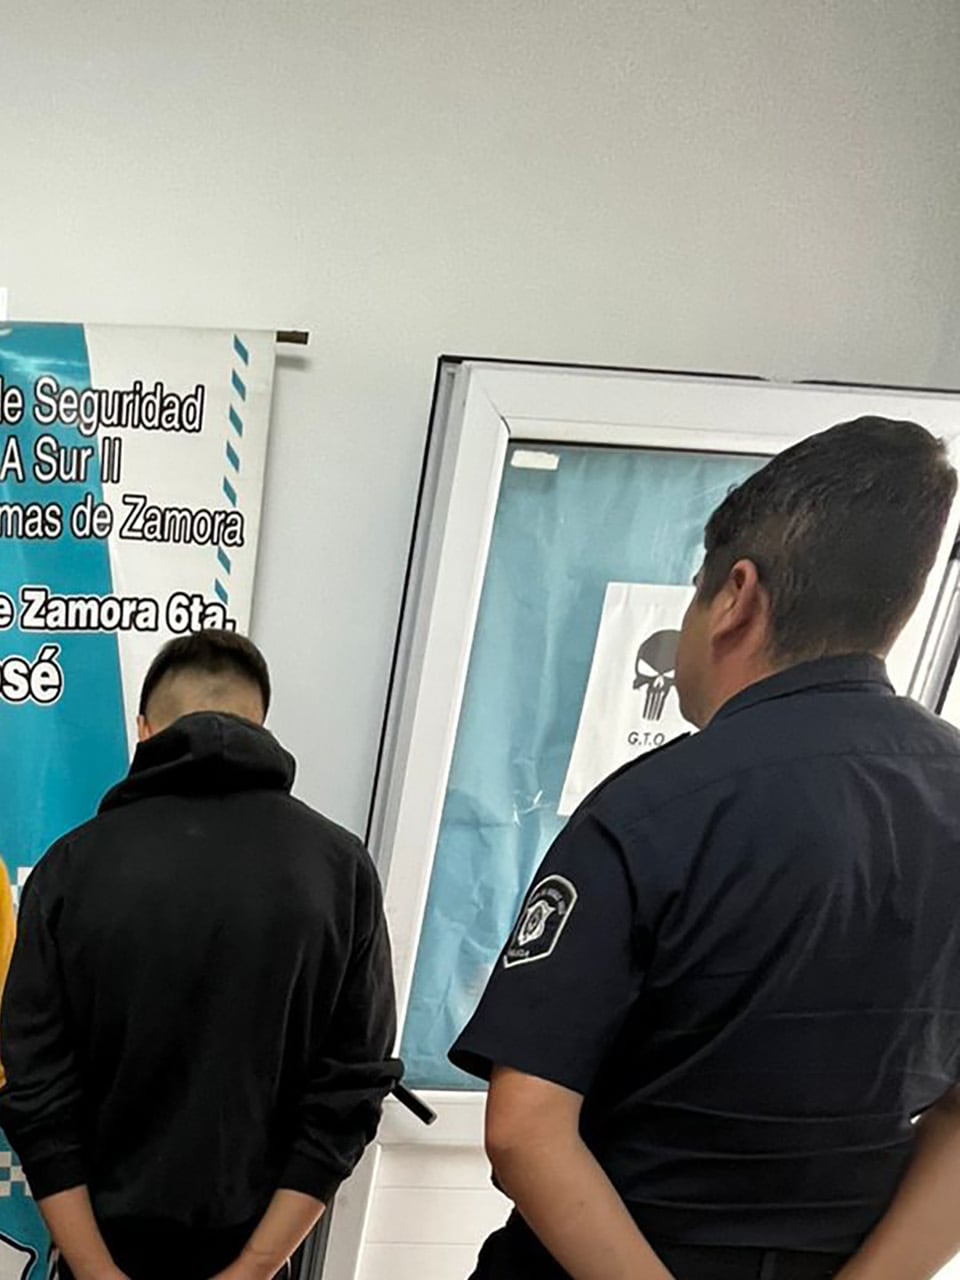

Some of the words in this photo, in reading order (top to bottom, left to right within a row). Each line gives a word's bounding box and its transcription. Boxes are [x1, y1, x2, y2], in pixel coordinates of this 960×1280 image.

[33, 378, 205, 432] Seguridad
[33, 440, 94, 483] Sur
[70, 501, 114, 540] de
[120, 495, 244, 547] Zamora
[22, 588, 158, 631] Zamora
